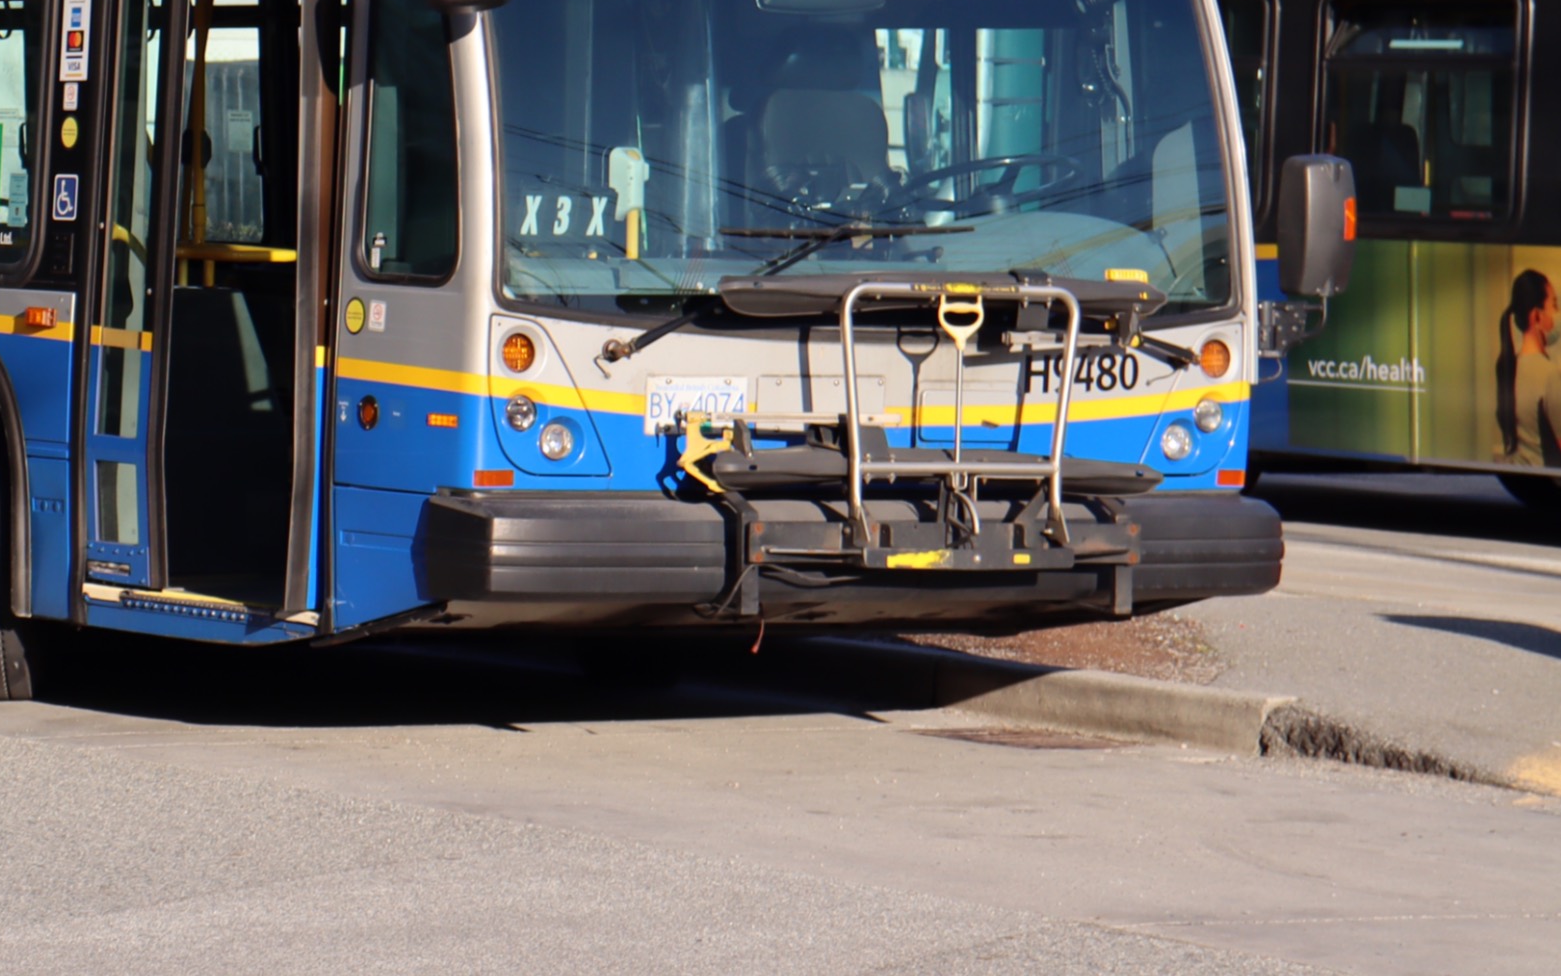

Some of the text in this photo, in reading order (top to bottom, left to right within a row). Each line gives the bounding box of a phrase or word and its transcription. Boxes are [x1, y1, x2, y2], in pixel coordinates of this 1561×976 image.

[0, 231, 13, 246] Ltd.
[1307, 354, 1426, 384] vcc.ca/health
[649, 392, 676, 419] BY
